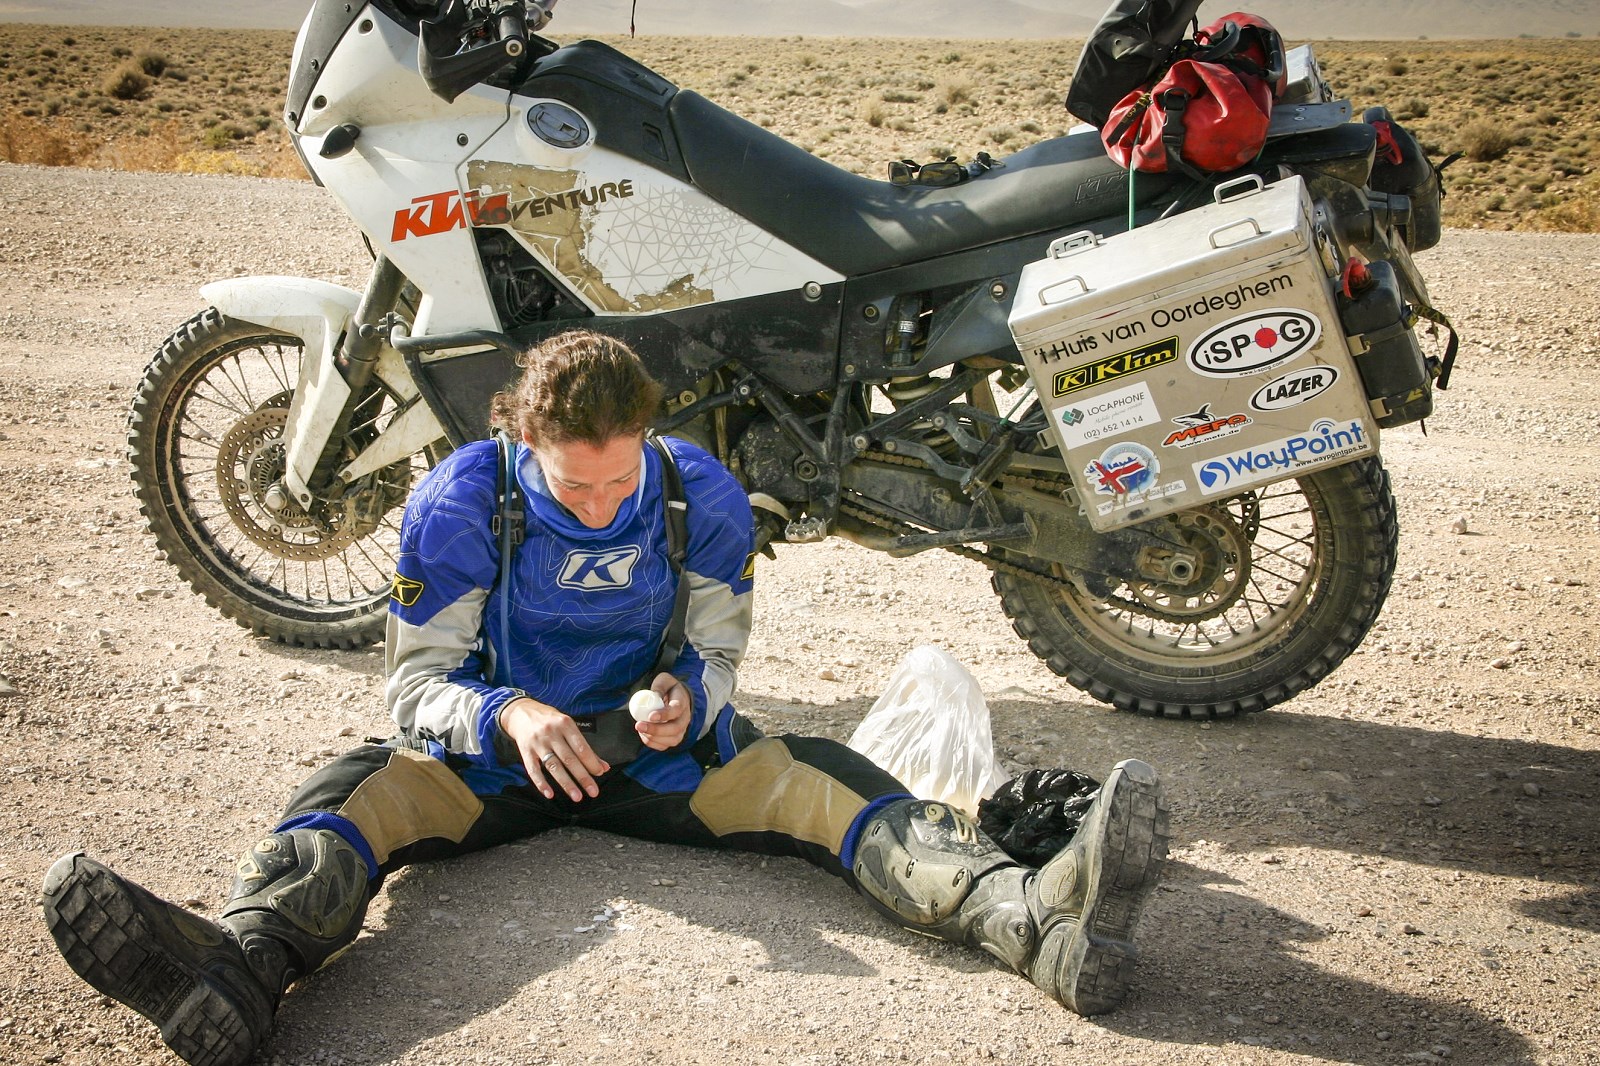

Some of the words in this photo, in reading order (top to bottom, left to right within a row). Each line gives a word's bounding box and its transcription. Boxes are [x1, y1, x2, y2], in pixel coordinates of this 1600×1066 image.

[391, 190, 508, 242] KTM
[475, 179, 634, 224] ADVENTURE
[1054, 334, 1098, 358] Huis
[1102, 322, 1146, 343] van
[1151, 274, 1293, 328] Oordeghem
[1266, 374, 1324, 402] LAZER
[1087, 392, 1145, 416] LOCAPHONE
[1083, 429, 1101, 440] (02)
[1103, 423, 1118, 433] 652
[1121, 419, 1131, 427] 14
[1133, 415, 1144, 424] 14
[1162, 414, 1247, 446] MEFO
[1180, 429, 1240, 448] www.mefo.de
[1226, 421, 1363, 471] WayPoint
[1294, 444, 1368, 468] www.waypointgps.be
